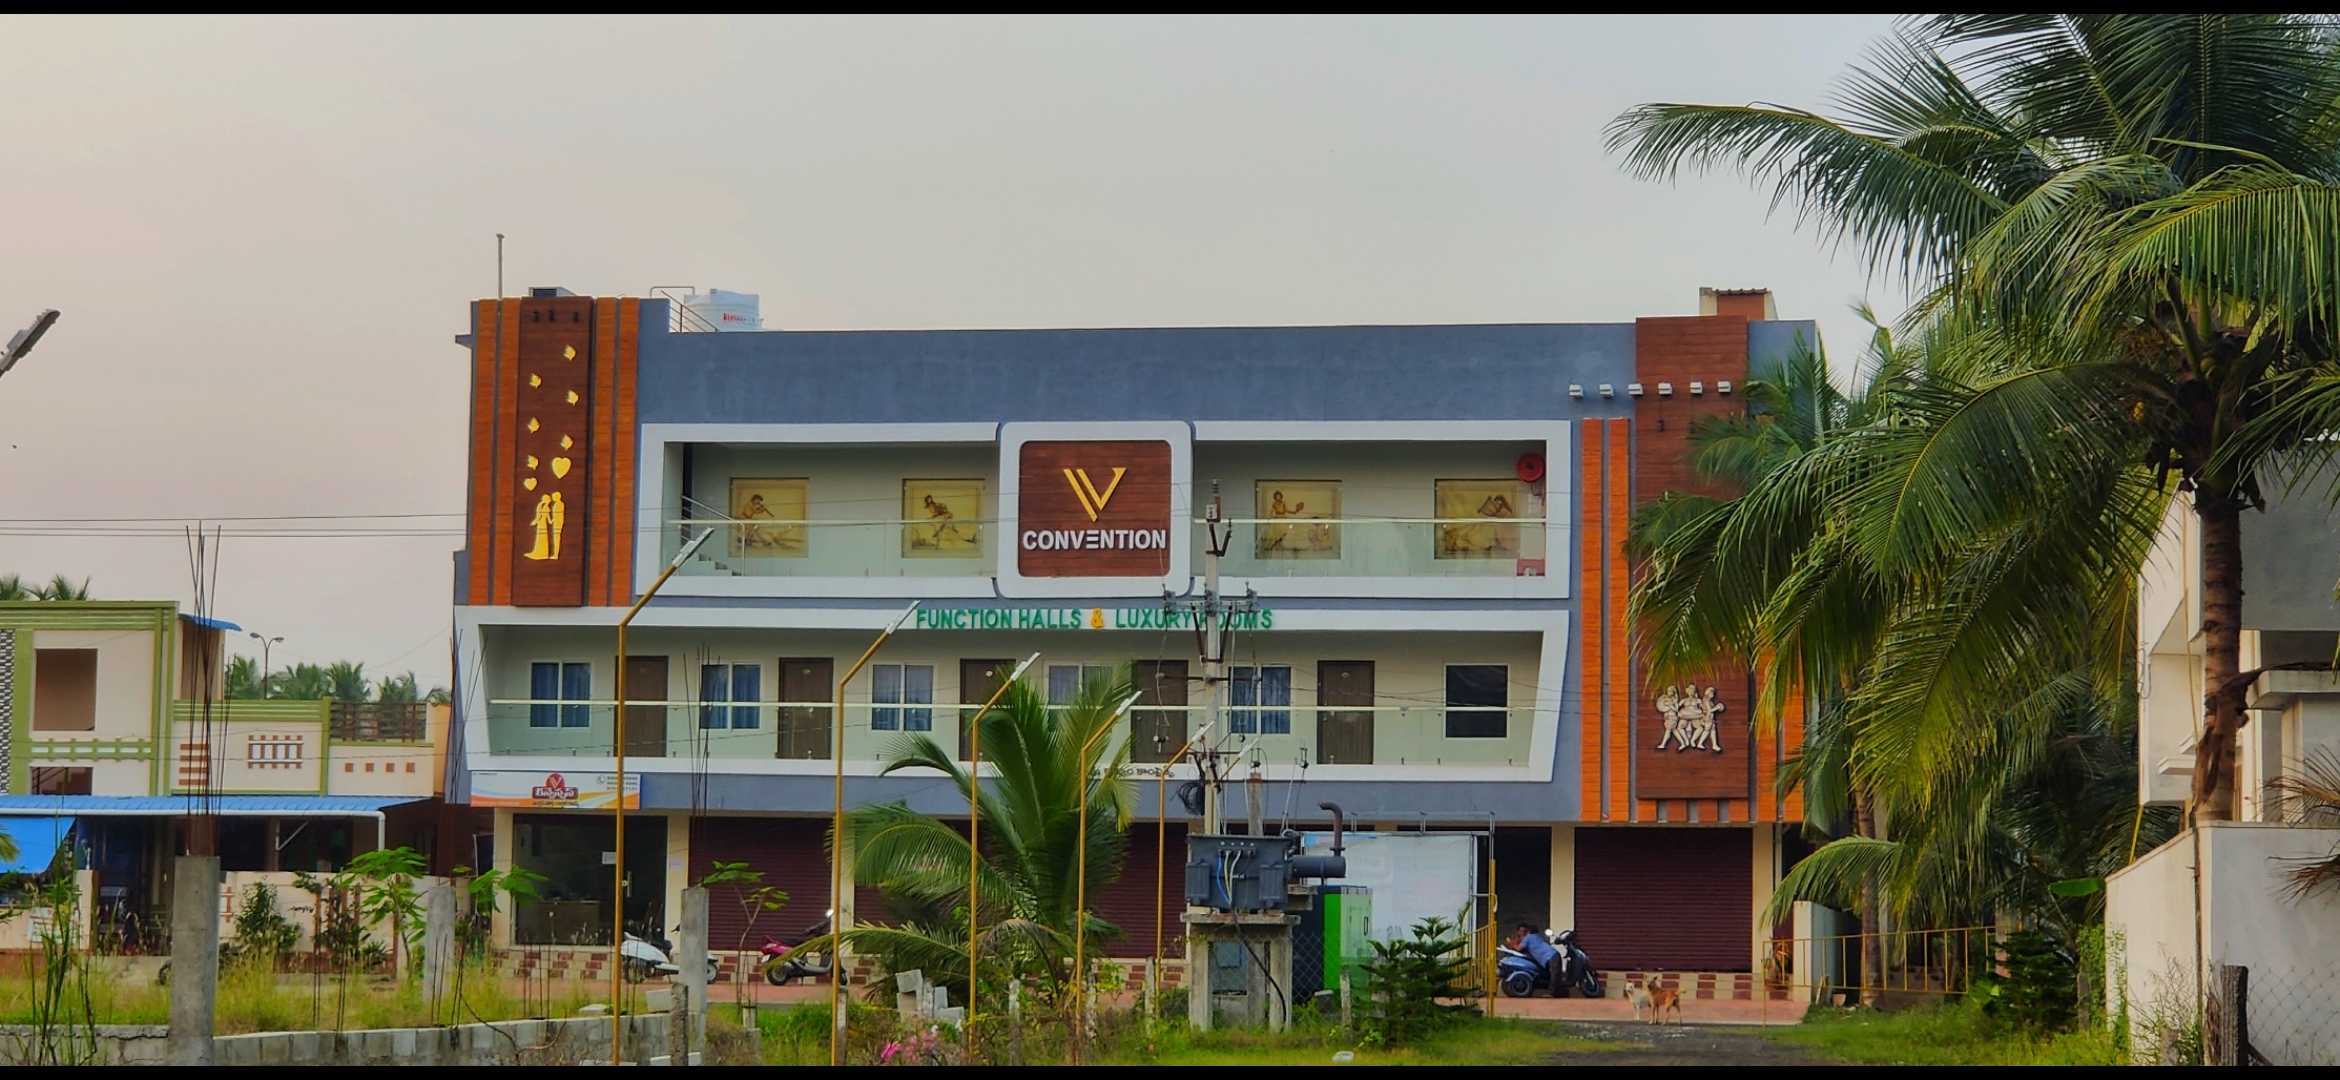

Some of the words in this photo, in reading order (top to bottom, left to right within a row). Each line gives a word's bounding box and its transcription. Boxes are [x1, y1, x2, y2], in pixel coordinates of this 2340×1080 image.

[1022, 529, 1167, 550] CONVENTION
[916, 608, 1012, 629] FUNCTION
[1018, 608, 1082, 629] HALLS
[1090, 607, 1105, 629] &
[1115, 608, 1192, 629] LUXURY
